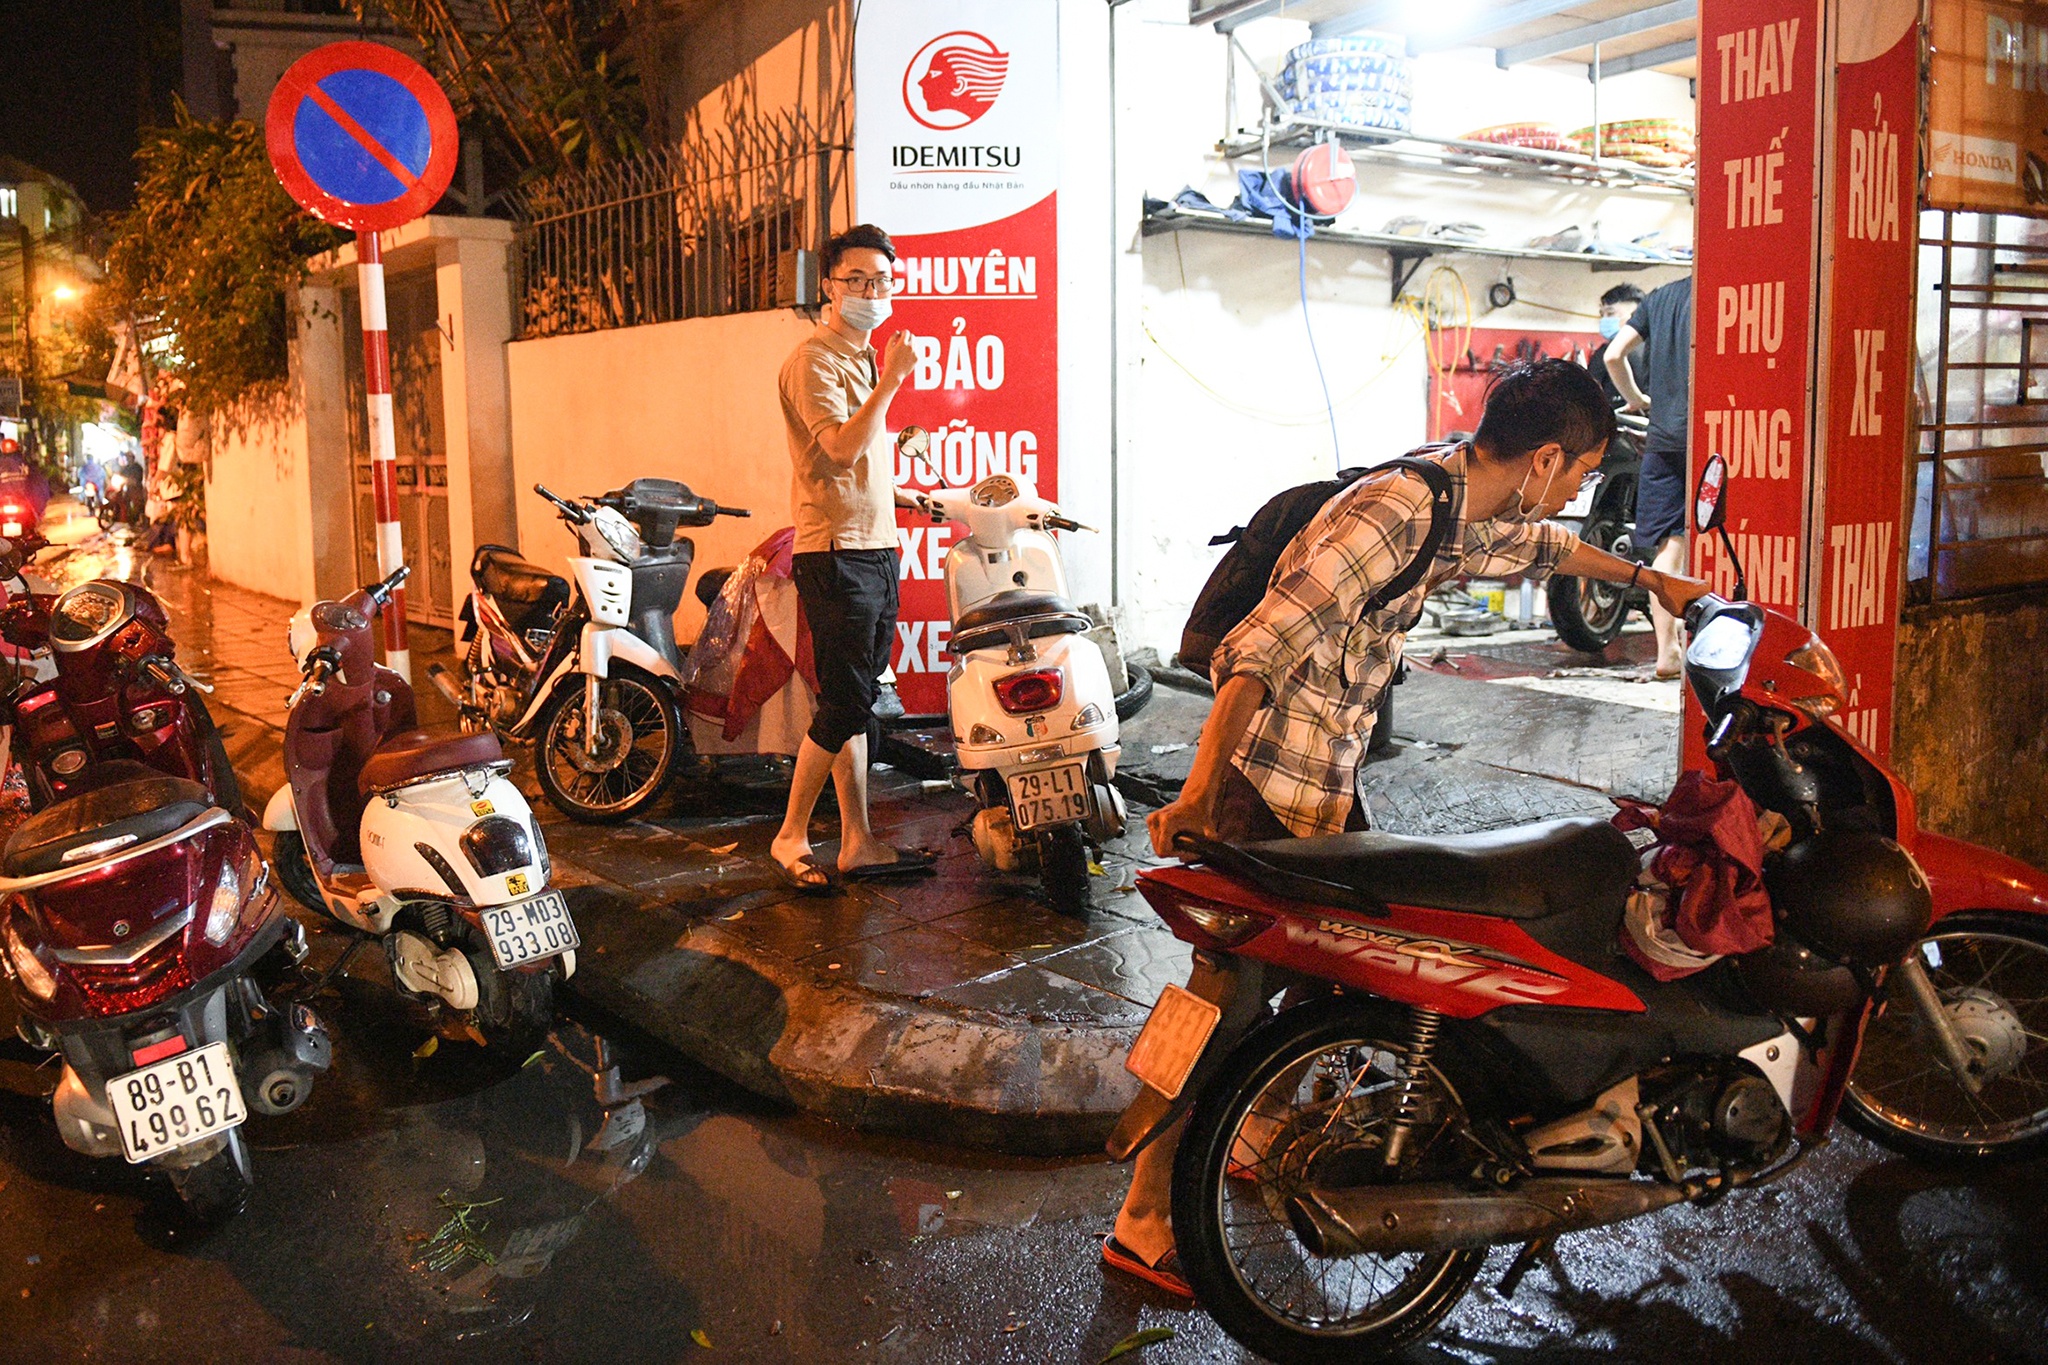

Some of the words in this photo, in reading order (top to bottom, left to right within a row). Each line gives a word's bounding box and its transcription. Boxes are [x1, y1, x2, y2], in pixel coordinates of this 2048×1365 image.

[1717, 18, 1800, 104] THAY
[893, 145, 1021, 167] IDEMITSU
[1724, 127, 1789, 229] THẾ
[1848, 92, 1899, 241] RỬA
[1953, 151, 2014, 173] HONDA
[892, 249, 1036, 294] CHUYÊN
[914, 317, 1004, 390] BẢO
[1717, 281, 1785, 369] PHỤ
[1850, 329, 1885, 436] XE
[887, 419, 1037, 486] DƯỠNG
[1705, 395, 1791, 479] TÙNG
[896, 527, 951, 580] XE
[1694, 518, 1795, 605] CHÍNH
[1831, 522, 1892, 630] THAY
[896, 621, 951, 673] XE
[1018, 793, 1085, 826] 075.19
[1019, 769, 1074, 799] 29-L1
[499, 922, 573, 963] 933.08
[127, 1054, 213, 1111] 89-B1
[131, 1088, 237, 1152] 499.62
